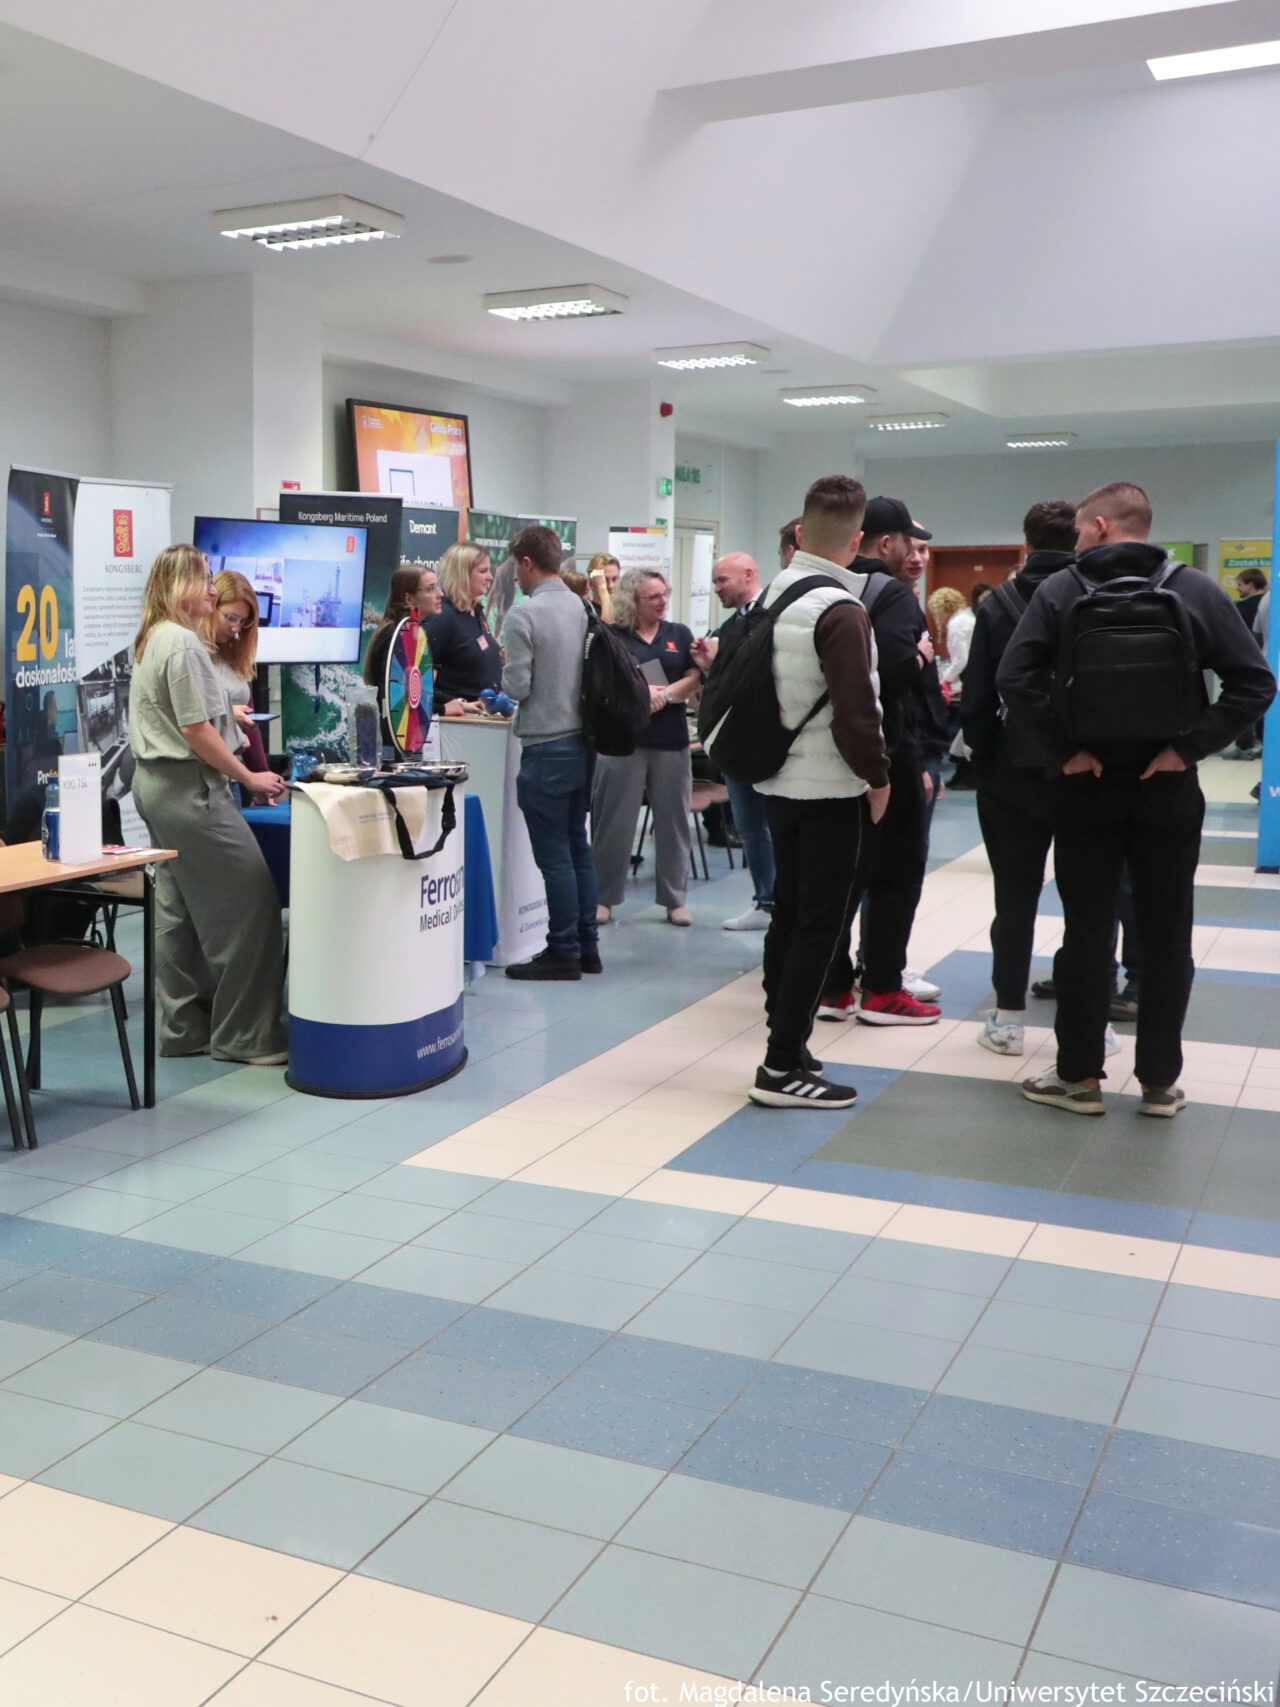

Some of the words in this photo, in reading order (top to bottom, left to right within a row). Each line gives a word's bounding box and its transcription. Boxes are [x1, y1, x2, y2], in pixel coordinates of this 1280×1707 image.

[298, 511, 333, 523] Kongsberg
[334, 512, 364, 523] Maritime
[365, 513, 387, 523] Poland
[409, 520, 437, 535] Demant
[105, 565, 142, 574] KONGSBERG
[16, 584, 59, 661] 20
[64, 632, 75, 658] la
[16, 662, 76, 688] doskonałoś
[420, 906, 451, 932] Medical
